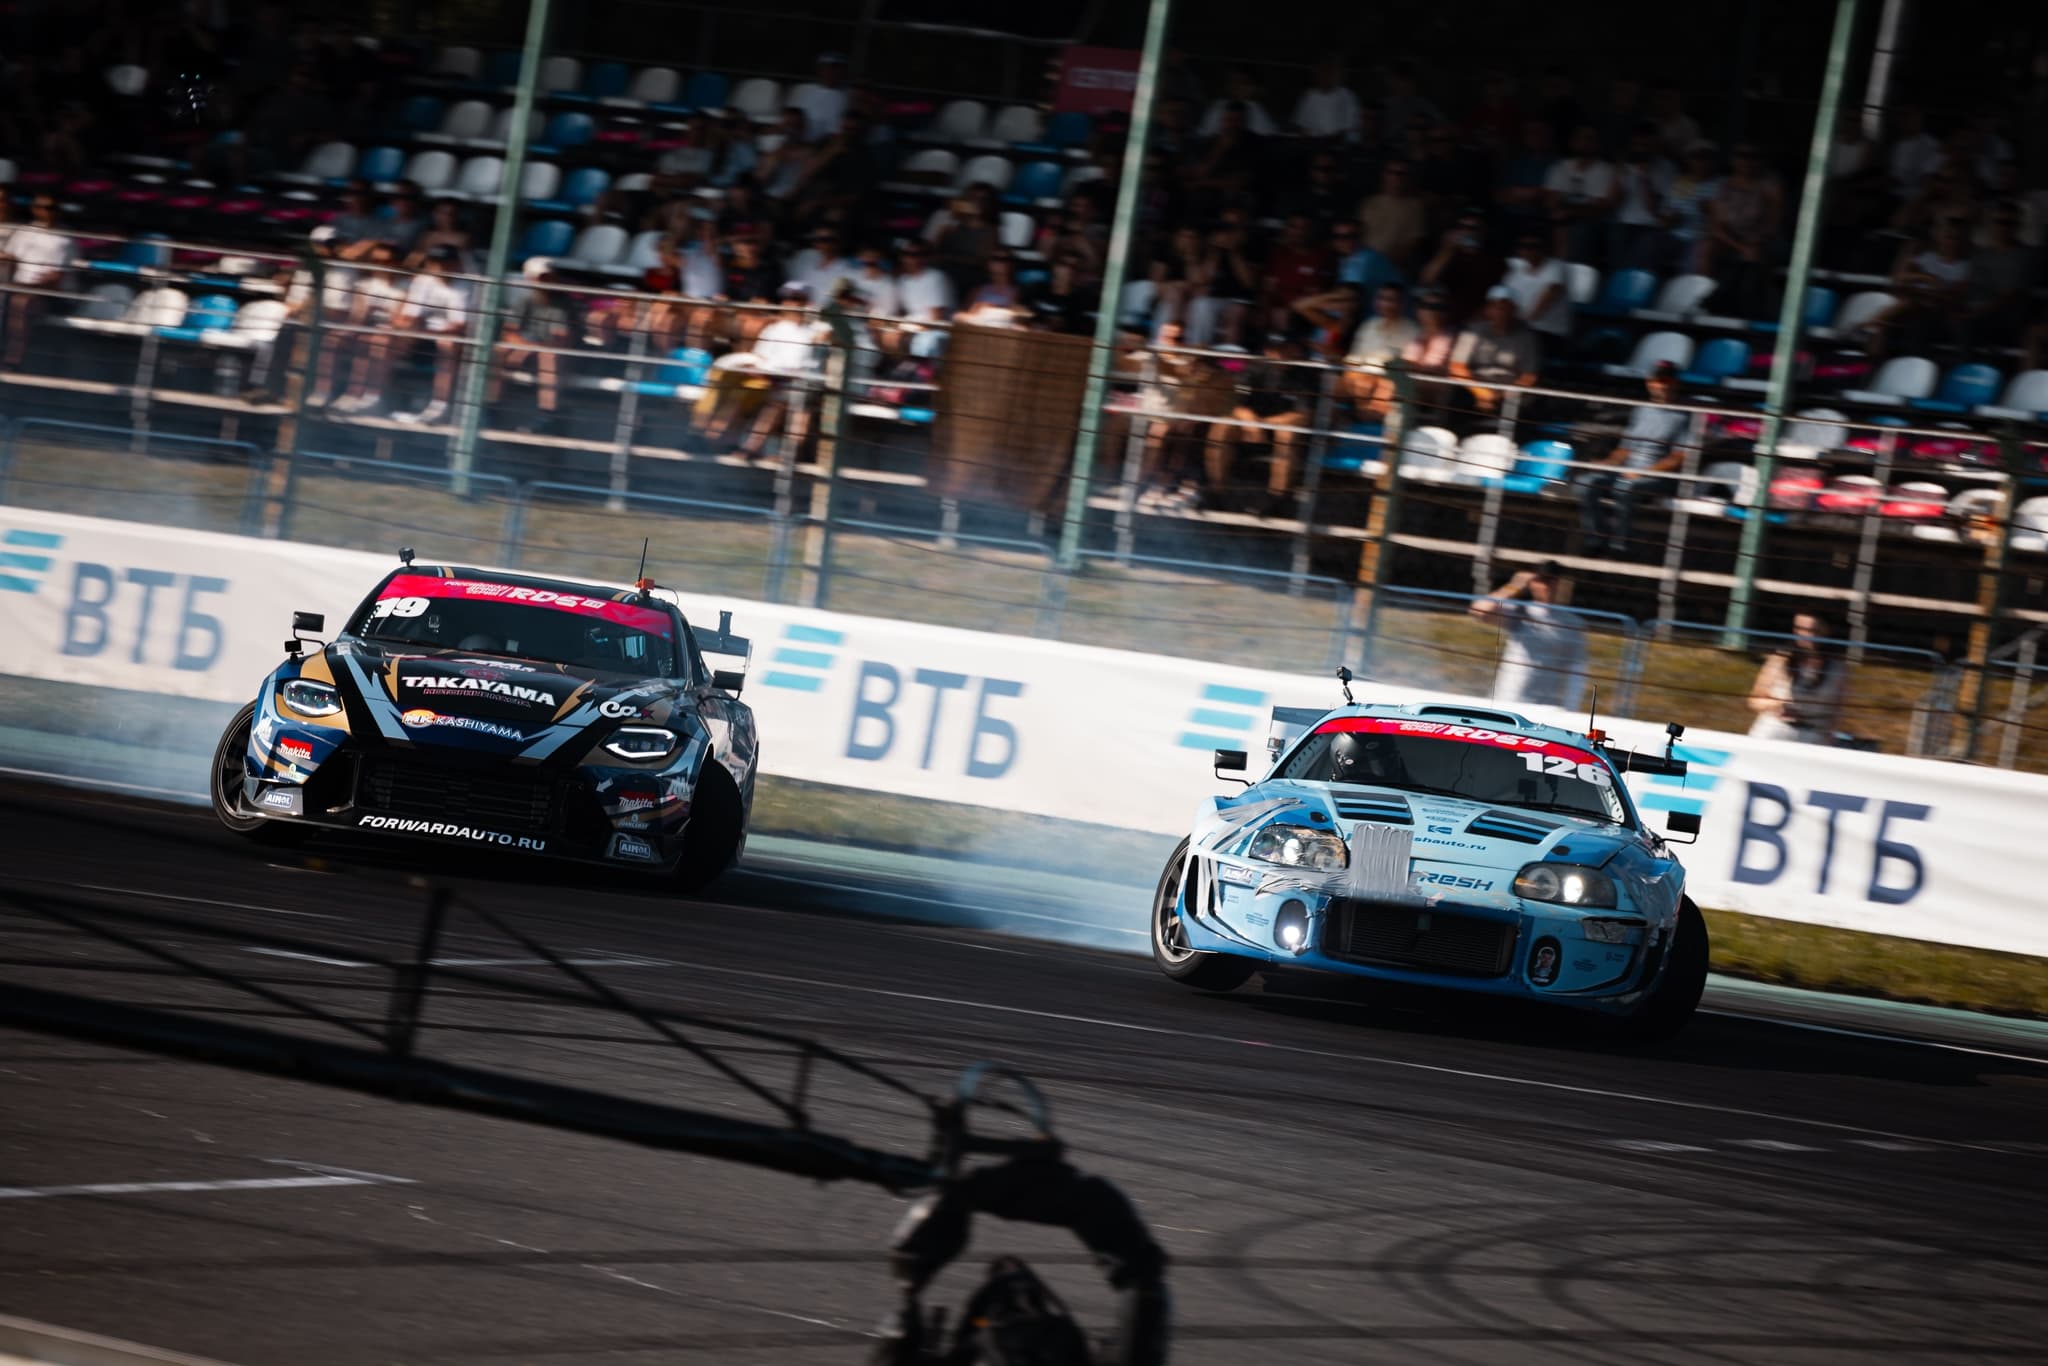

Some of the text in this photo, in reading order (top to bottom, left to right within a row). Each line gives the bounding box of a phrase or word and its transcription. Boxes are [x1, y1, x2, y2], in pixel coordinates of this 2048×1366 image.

[60, 561, 230, 671] ВТБ
[374, 596, 430, 617] 19
[401, 676, 556, 706] TAKAYAMA
[435, 716, 524, 741] KASHIYAMA
[845, 660, 1024, 779] ВТБ
[1517, 752, 1612, 787] 126
[358, 815, 546, 850] FORWARDAUTO.RU
[1732, 781, 1932, 905] ВТБ
